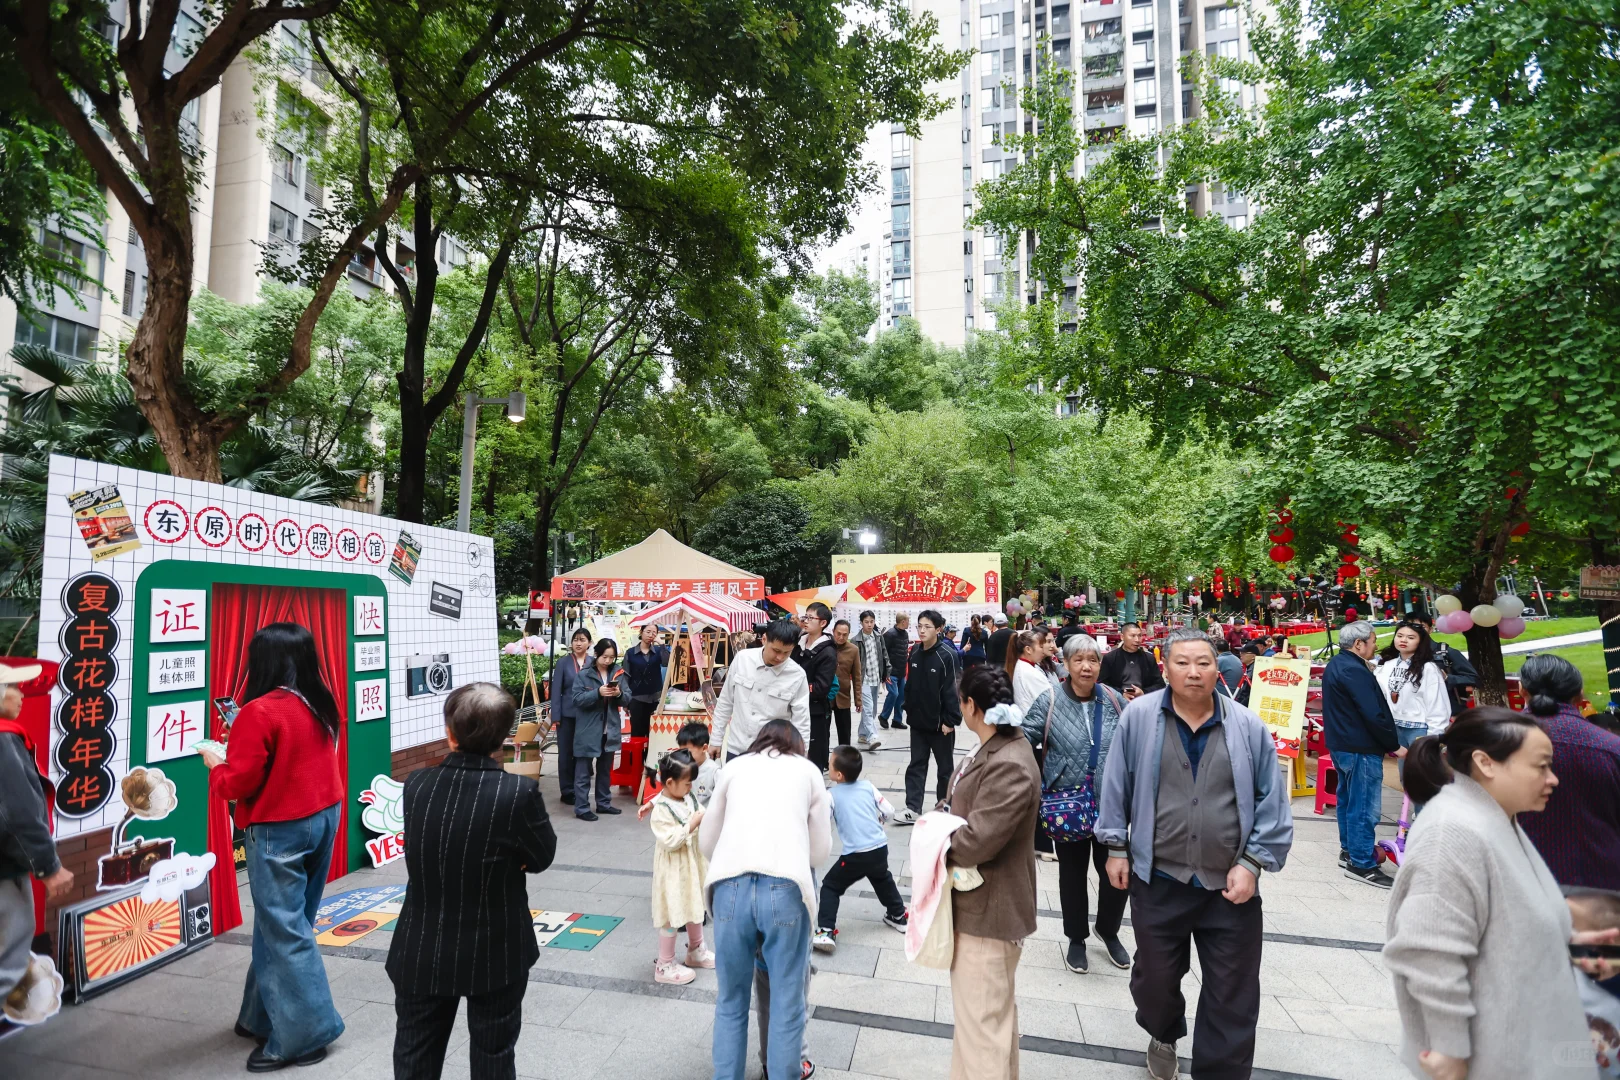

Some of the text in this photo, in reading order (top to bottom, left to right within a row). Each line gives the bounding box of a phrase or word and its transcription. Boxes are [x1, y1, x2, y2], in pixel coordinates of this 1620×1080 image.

[156, 509, 382, 558] 东原时代照相馆
[610, 581, 760, 598] 青藏特产 手撕风干
[878, 574, 955, 597] 老友生活节
[155, 599, 200, 636] 证
[359, 602, 382, 631] 快
[159, 656, 196, 670] 儿童照
[158, 671, 196, 685] 集体照
[67, 582, 110, 809] 复古花样年华
[360, 685, 383, 715] 照
[153, 709, 197, 752] 件
[532, 922, 565, 933] 2
[569, 927, 606, 937] 1
